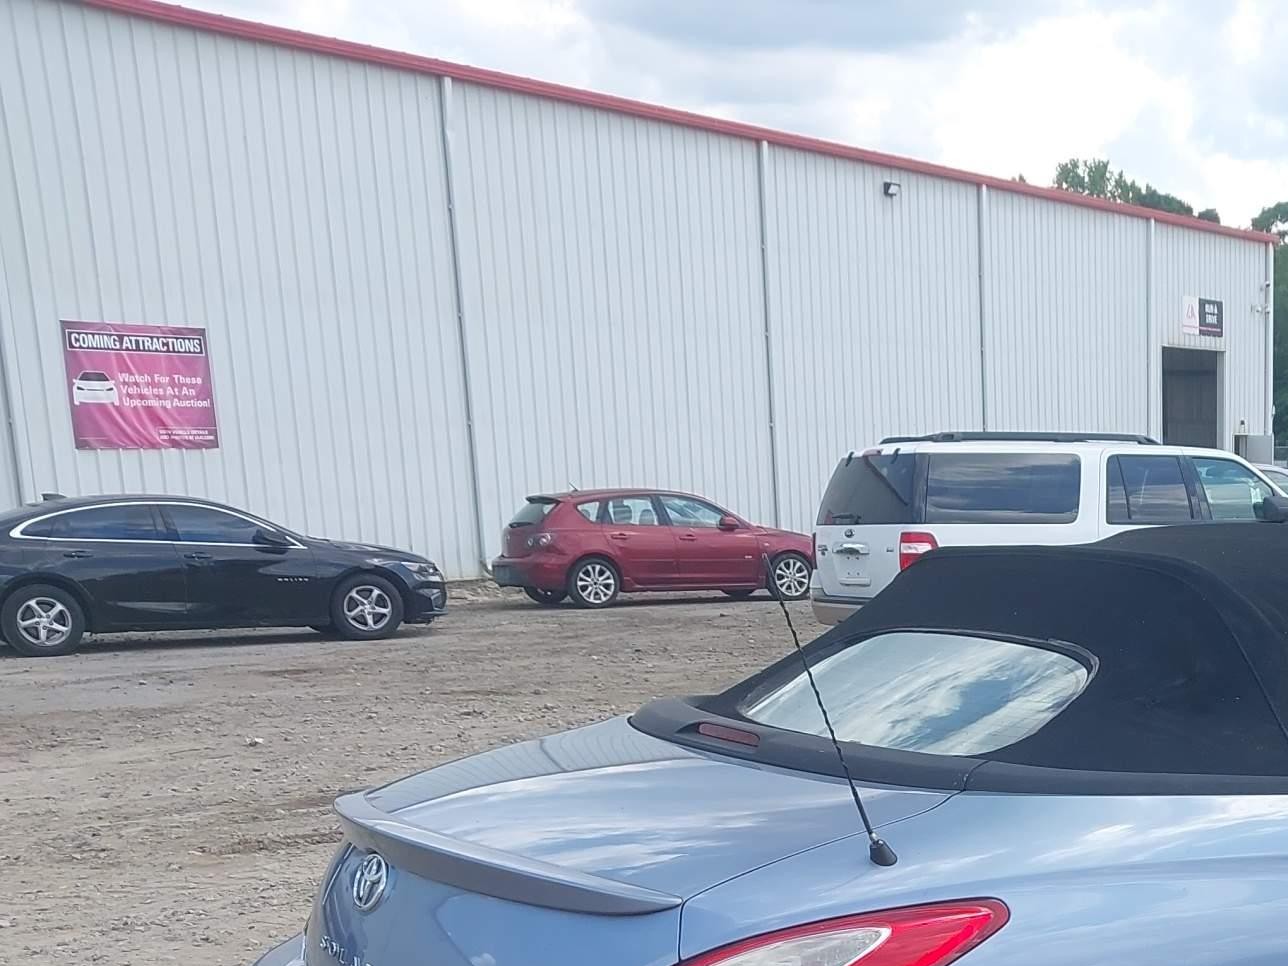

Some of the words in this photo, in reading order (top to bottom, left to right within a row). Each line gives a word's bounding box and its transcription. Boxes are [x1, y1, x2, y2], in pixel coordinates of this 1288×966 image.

[71, 333, 120, 350] COMING
[122, 336, 201, 353] ATTRACTIONS
[118, 372, 151, 383] Watch
[154, 373, 170, 384] For
[173, 374, 202, 385] These
[120, 384, 165, 395] Vehicles
[166, 386, 179, 396] At
[181, 386, 196, 396] An
[122, 396, 172, 409] Upcoming
[173, 398, 211, 408] Auction!
